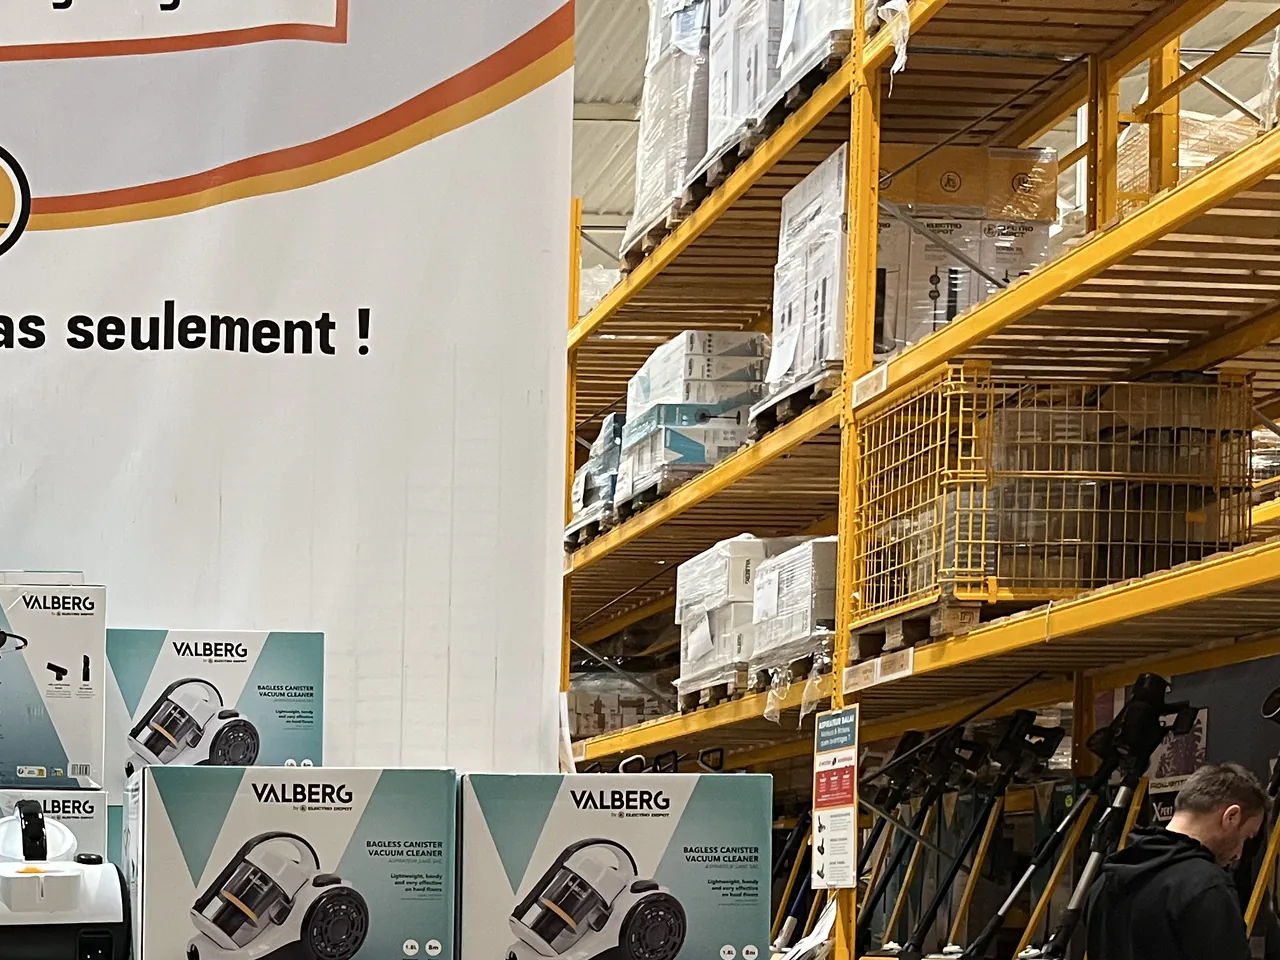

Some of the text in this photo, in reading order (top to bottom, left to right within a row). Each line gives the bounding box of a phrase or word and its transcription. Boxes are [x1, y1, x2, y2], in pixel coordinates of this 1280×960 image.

[66, 300, 336, 355] seulement
[357, 308, 371, 355] !
[22, 595, 95, 611] VALBERG
[172, 642, 248, 658] VALBERG
[251, 783, 353, 803] VALBERG
[570, 790, 670, 810] VALBERG
[42, 800, 95, 814] LBERG
[366, 840, 443, 849] BAGLESS CANISTER
[683, 846, 759, 854] BAGLESS CANISTER
[368, 849, 443, 857] VACUUM CLEANER
[685, 855, 759, 863] VACUUM CLEANER
